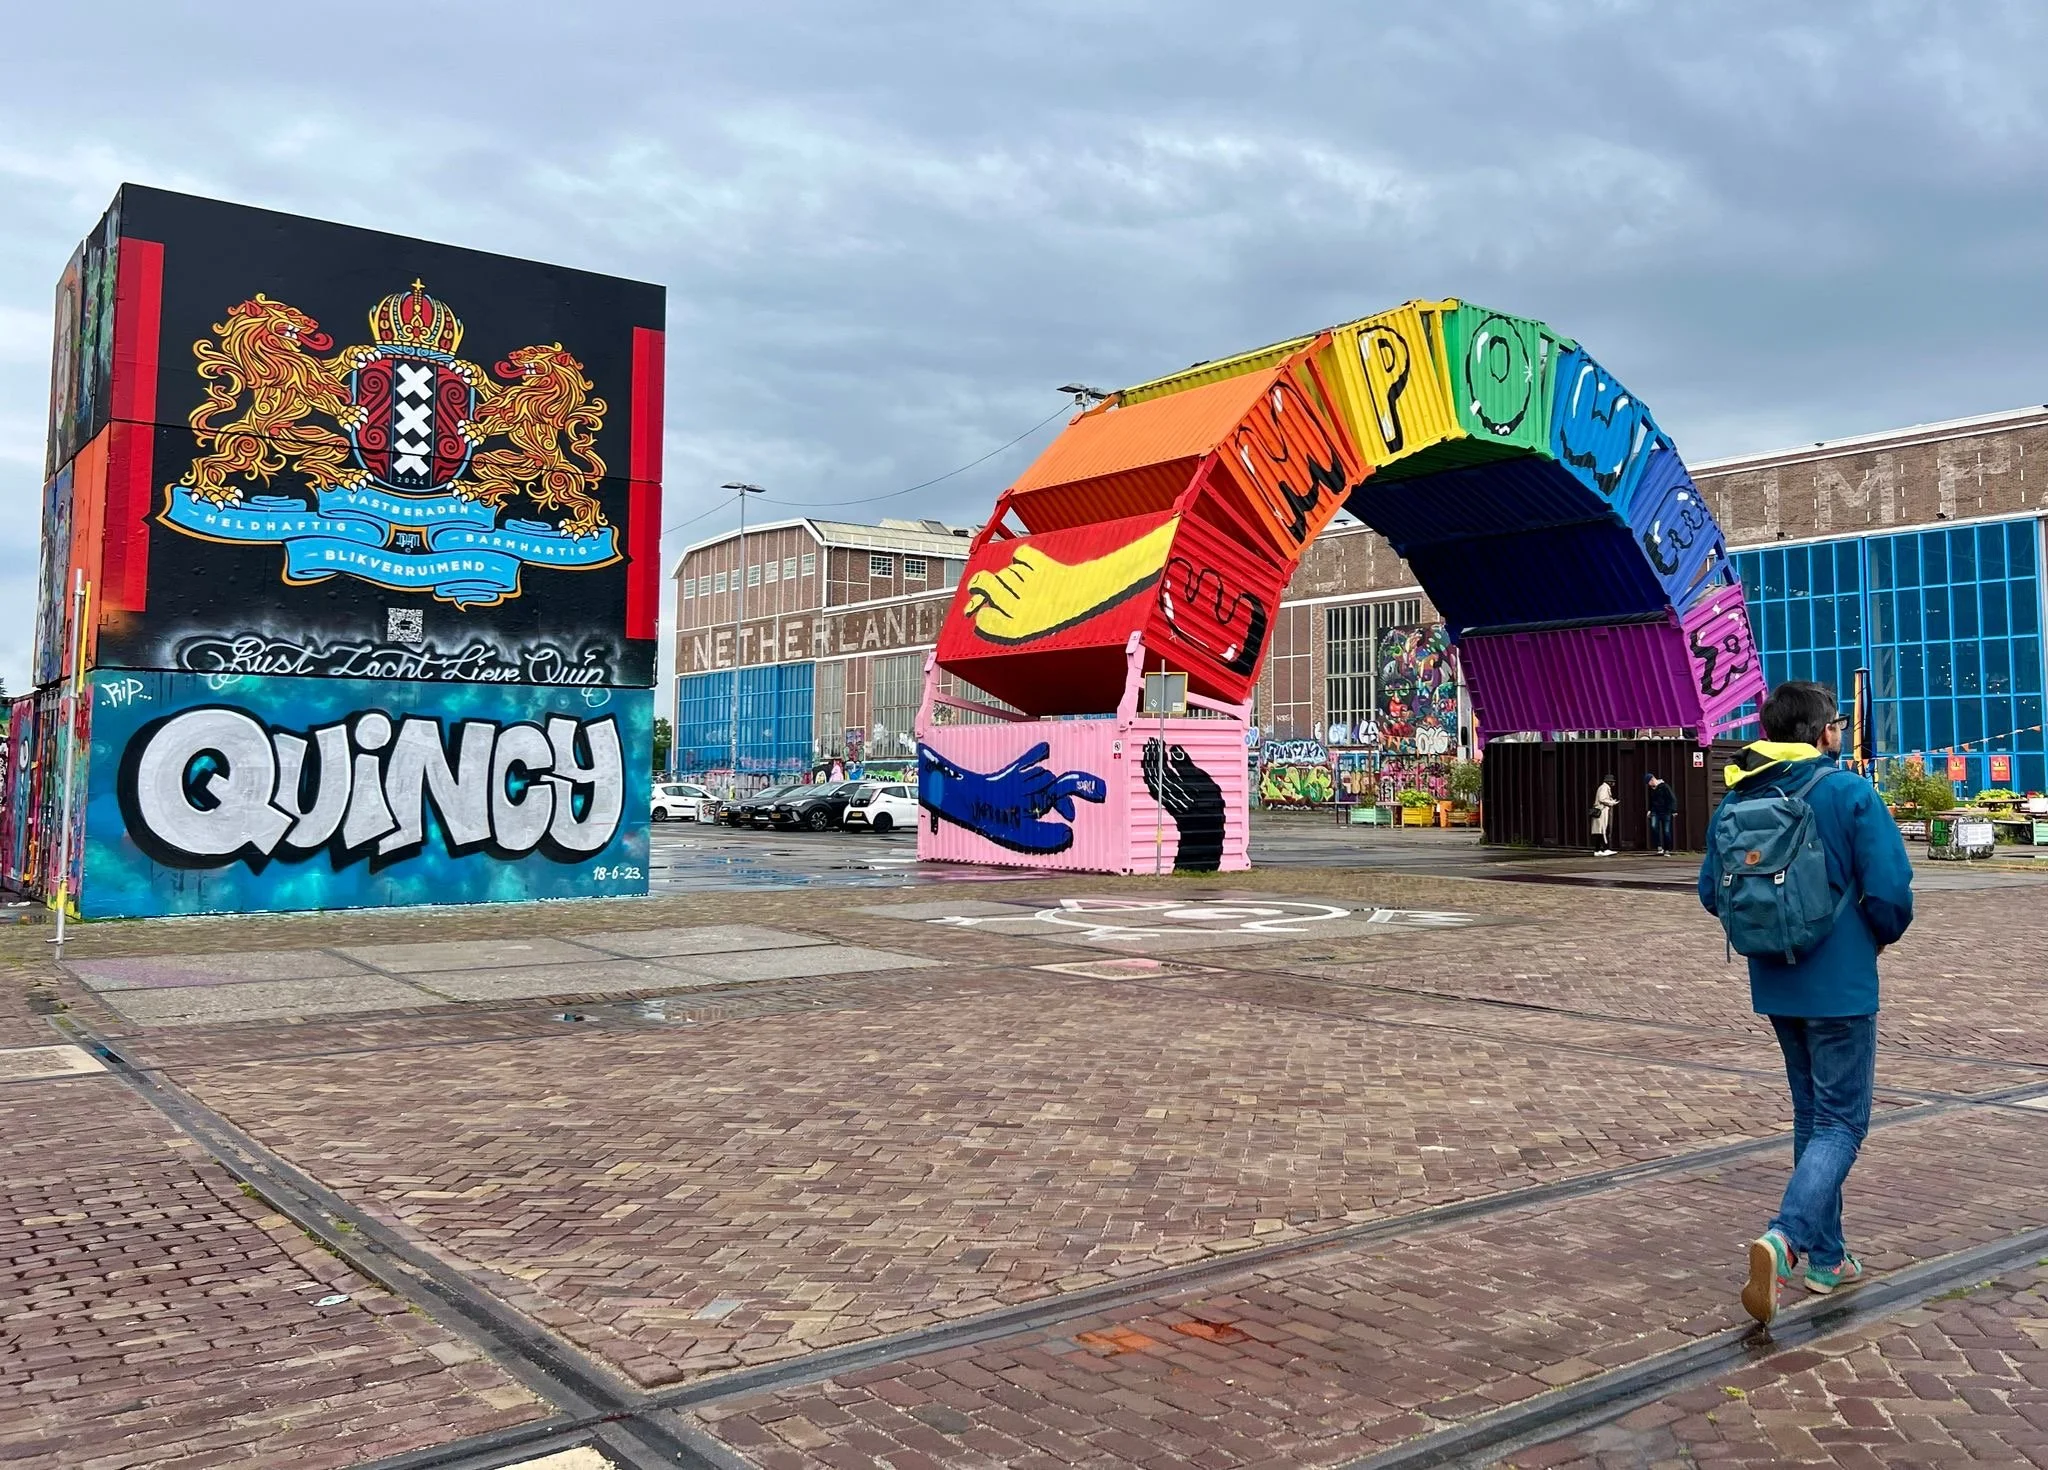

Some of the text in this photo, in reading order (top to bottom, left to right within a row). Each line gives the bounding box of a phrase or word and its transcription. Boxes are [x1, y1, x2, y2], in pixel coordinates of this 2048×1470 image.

[396, 476, 425, 486] 2024
[349, 494, 468, 517] VASTBERADEN
[205, 514, 347, 532] HELDHAFTIG
[466, 533, 587, 556] BARMHARTIG
[325, 549, 485, 577] BLIKVERRUIMEND
[187, 635, 320, 684] Rust
[442, 645, 520, 682] Lieve
